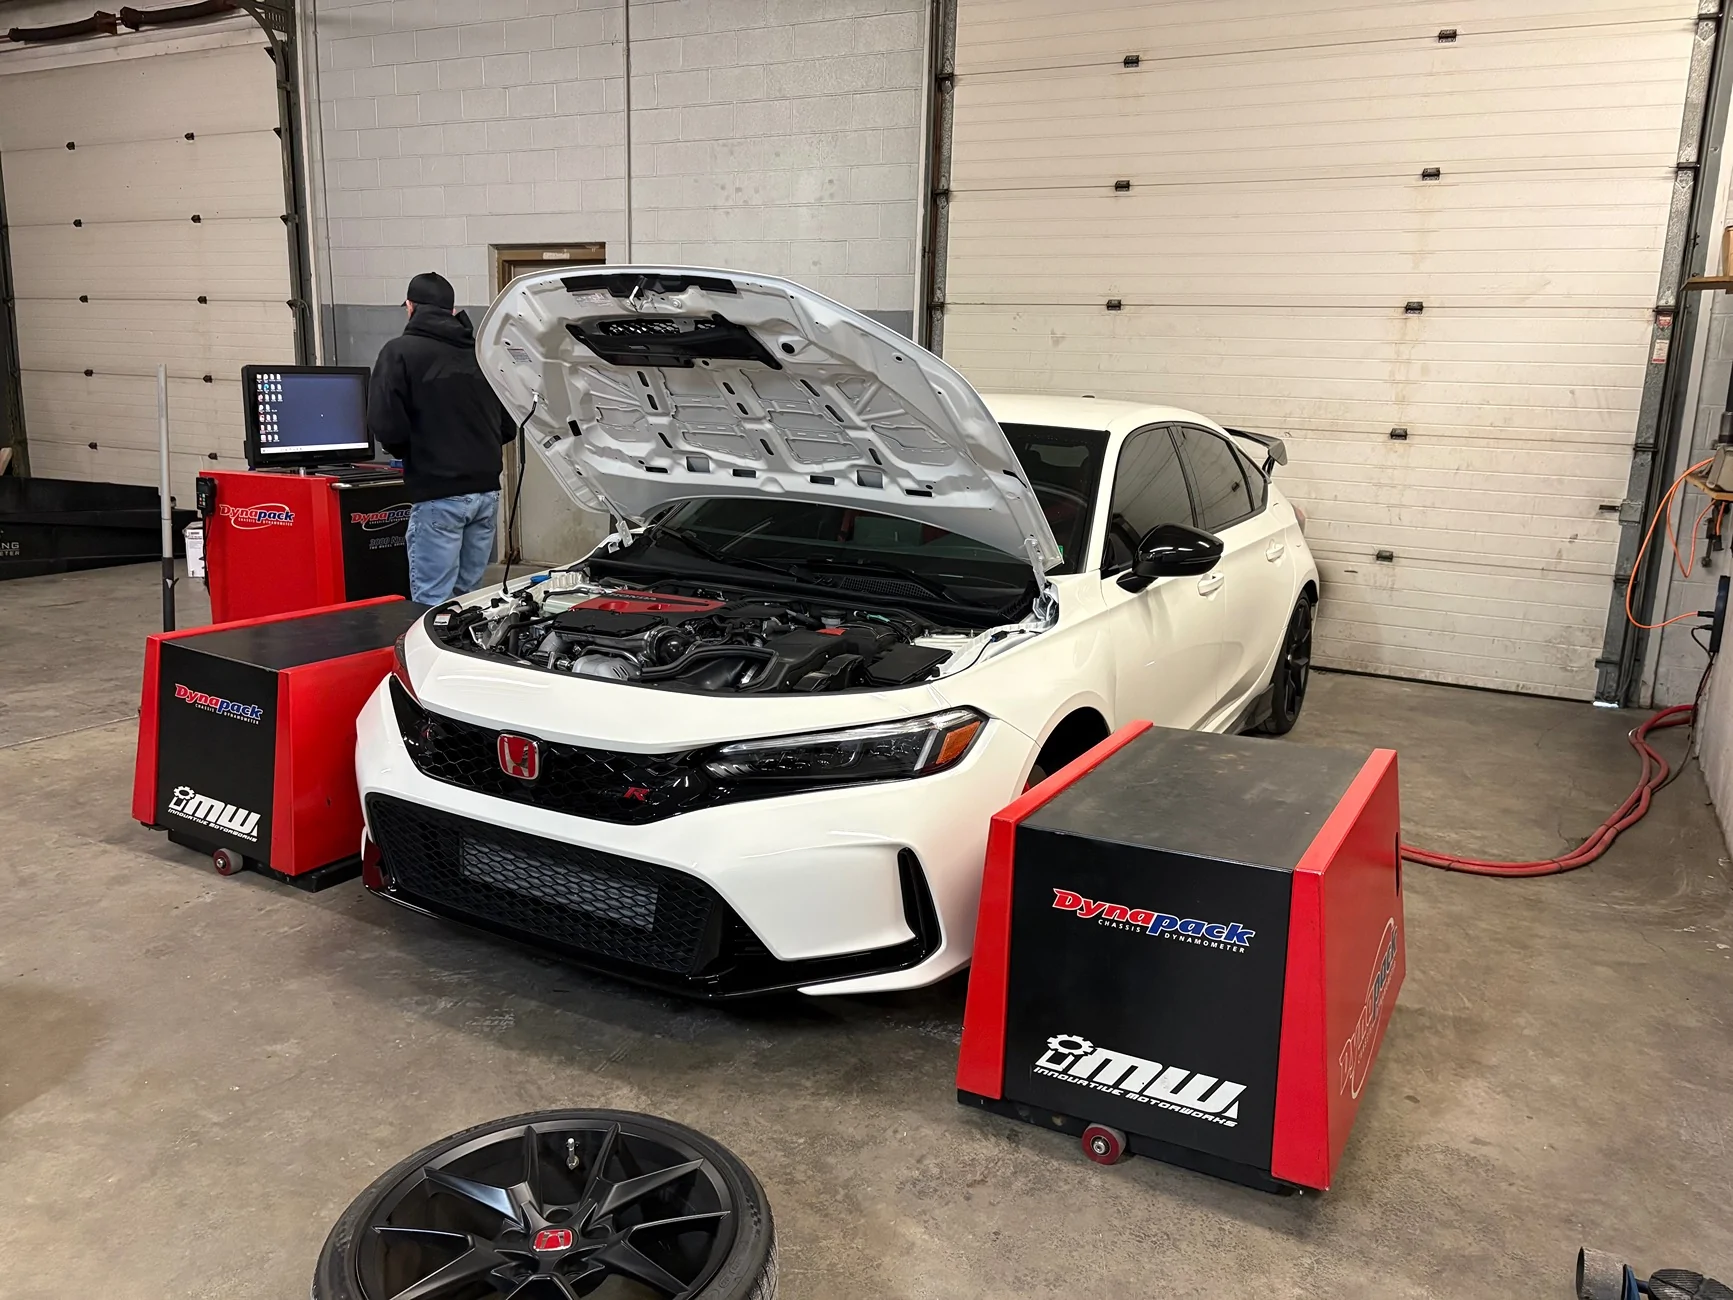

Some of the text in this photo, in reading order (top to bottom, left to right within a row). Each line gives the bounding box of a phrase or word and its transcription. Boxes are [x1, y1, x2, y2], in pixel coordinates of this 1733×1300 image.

[219, 504, 295, 523] Dynapack
[350, 508, 412, 524] Dynapac
[174, 683, 263, 720] Dynapack
[167, 808, 209, 826] INNOVATIVE
[1052, 888, 1256, 946] Dynapack
[1098, 919, 1246, 954] CHASSIS DYNAMOMETER
[1033, 1066, 1238, 1128] INNOVATIVE MOTORWORKS
